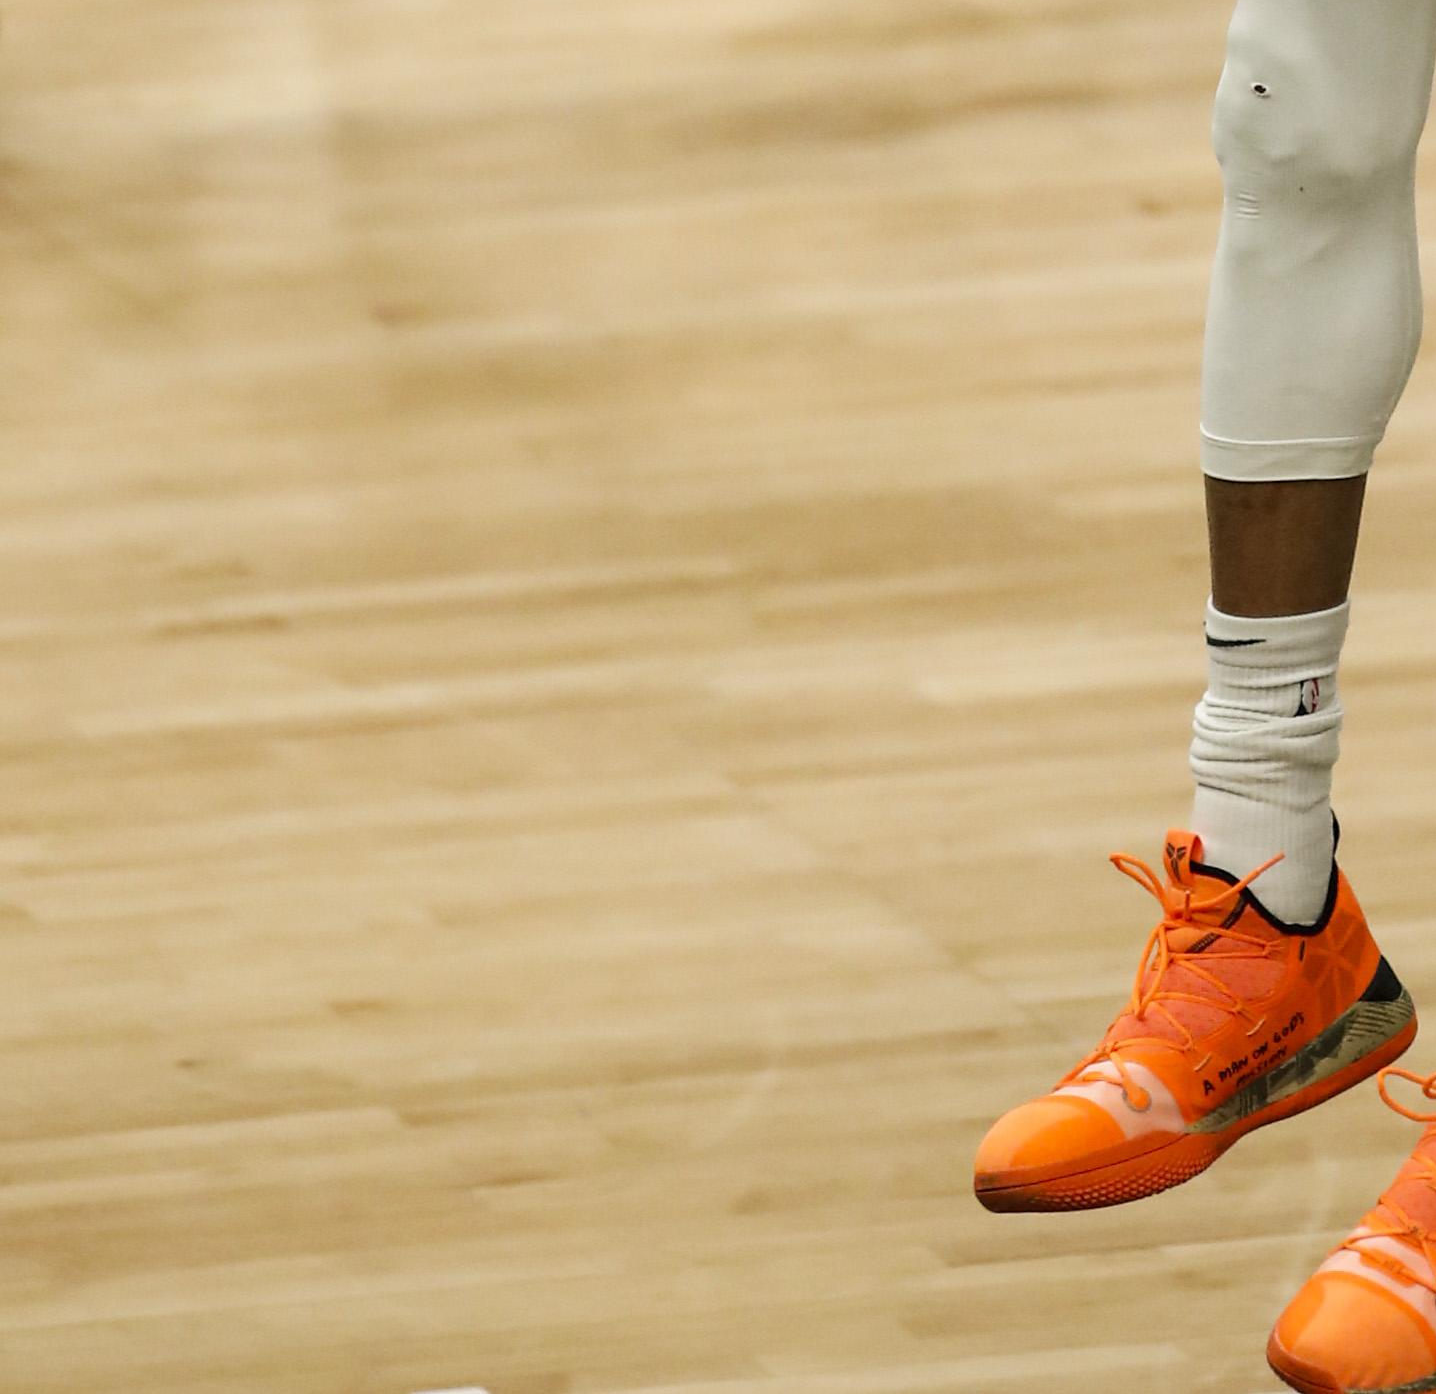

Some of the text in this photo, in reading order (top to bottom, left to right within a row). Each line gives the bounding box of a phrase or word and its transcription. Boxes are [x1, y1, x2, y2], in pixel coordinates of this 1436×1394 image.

[1203, 1079, 1215, 1096] A
[1218, 1056, 1248, 1082] MAN
[1252, 1041, 1268, 1059] ON
